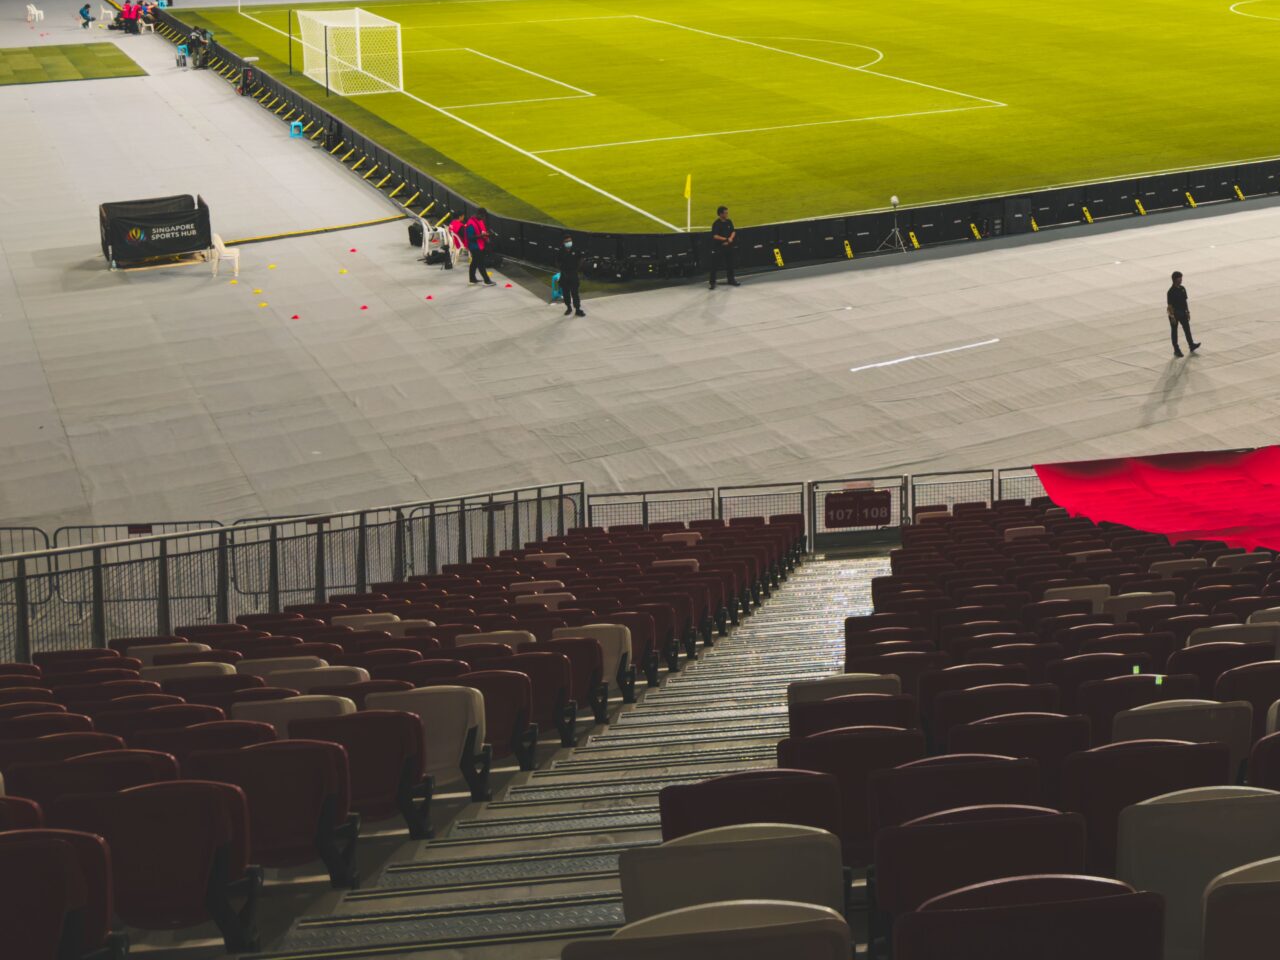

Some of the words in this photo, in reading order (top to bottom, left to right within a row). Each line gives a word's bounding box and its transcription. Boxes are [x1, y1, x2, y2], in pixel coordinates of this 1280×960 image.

[151, 223, 195, 234] SINGAPORE
[151, 231, 180, 241] SPORTS
[181, 229, 197, 238] HUB
[828, 509, 853, 521] 107
[862, 506, 888, 519] 108
